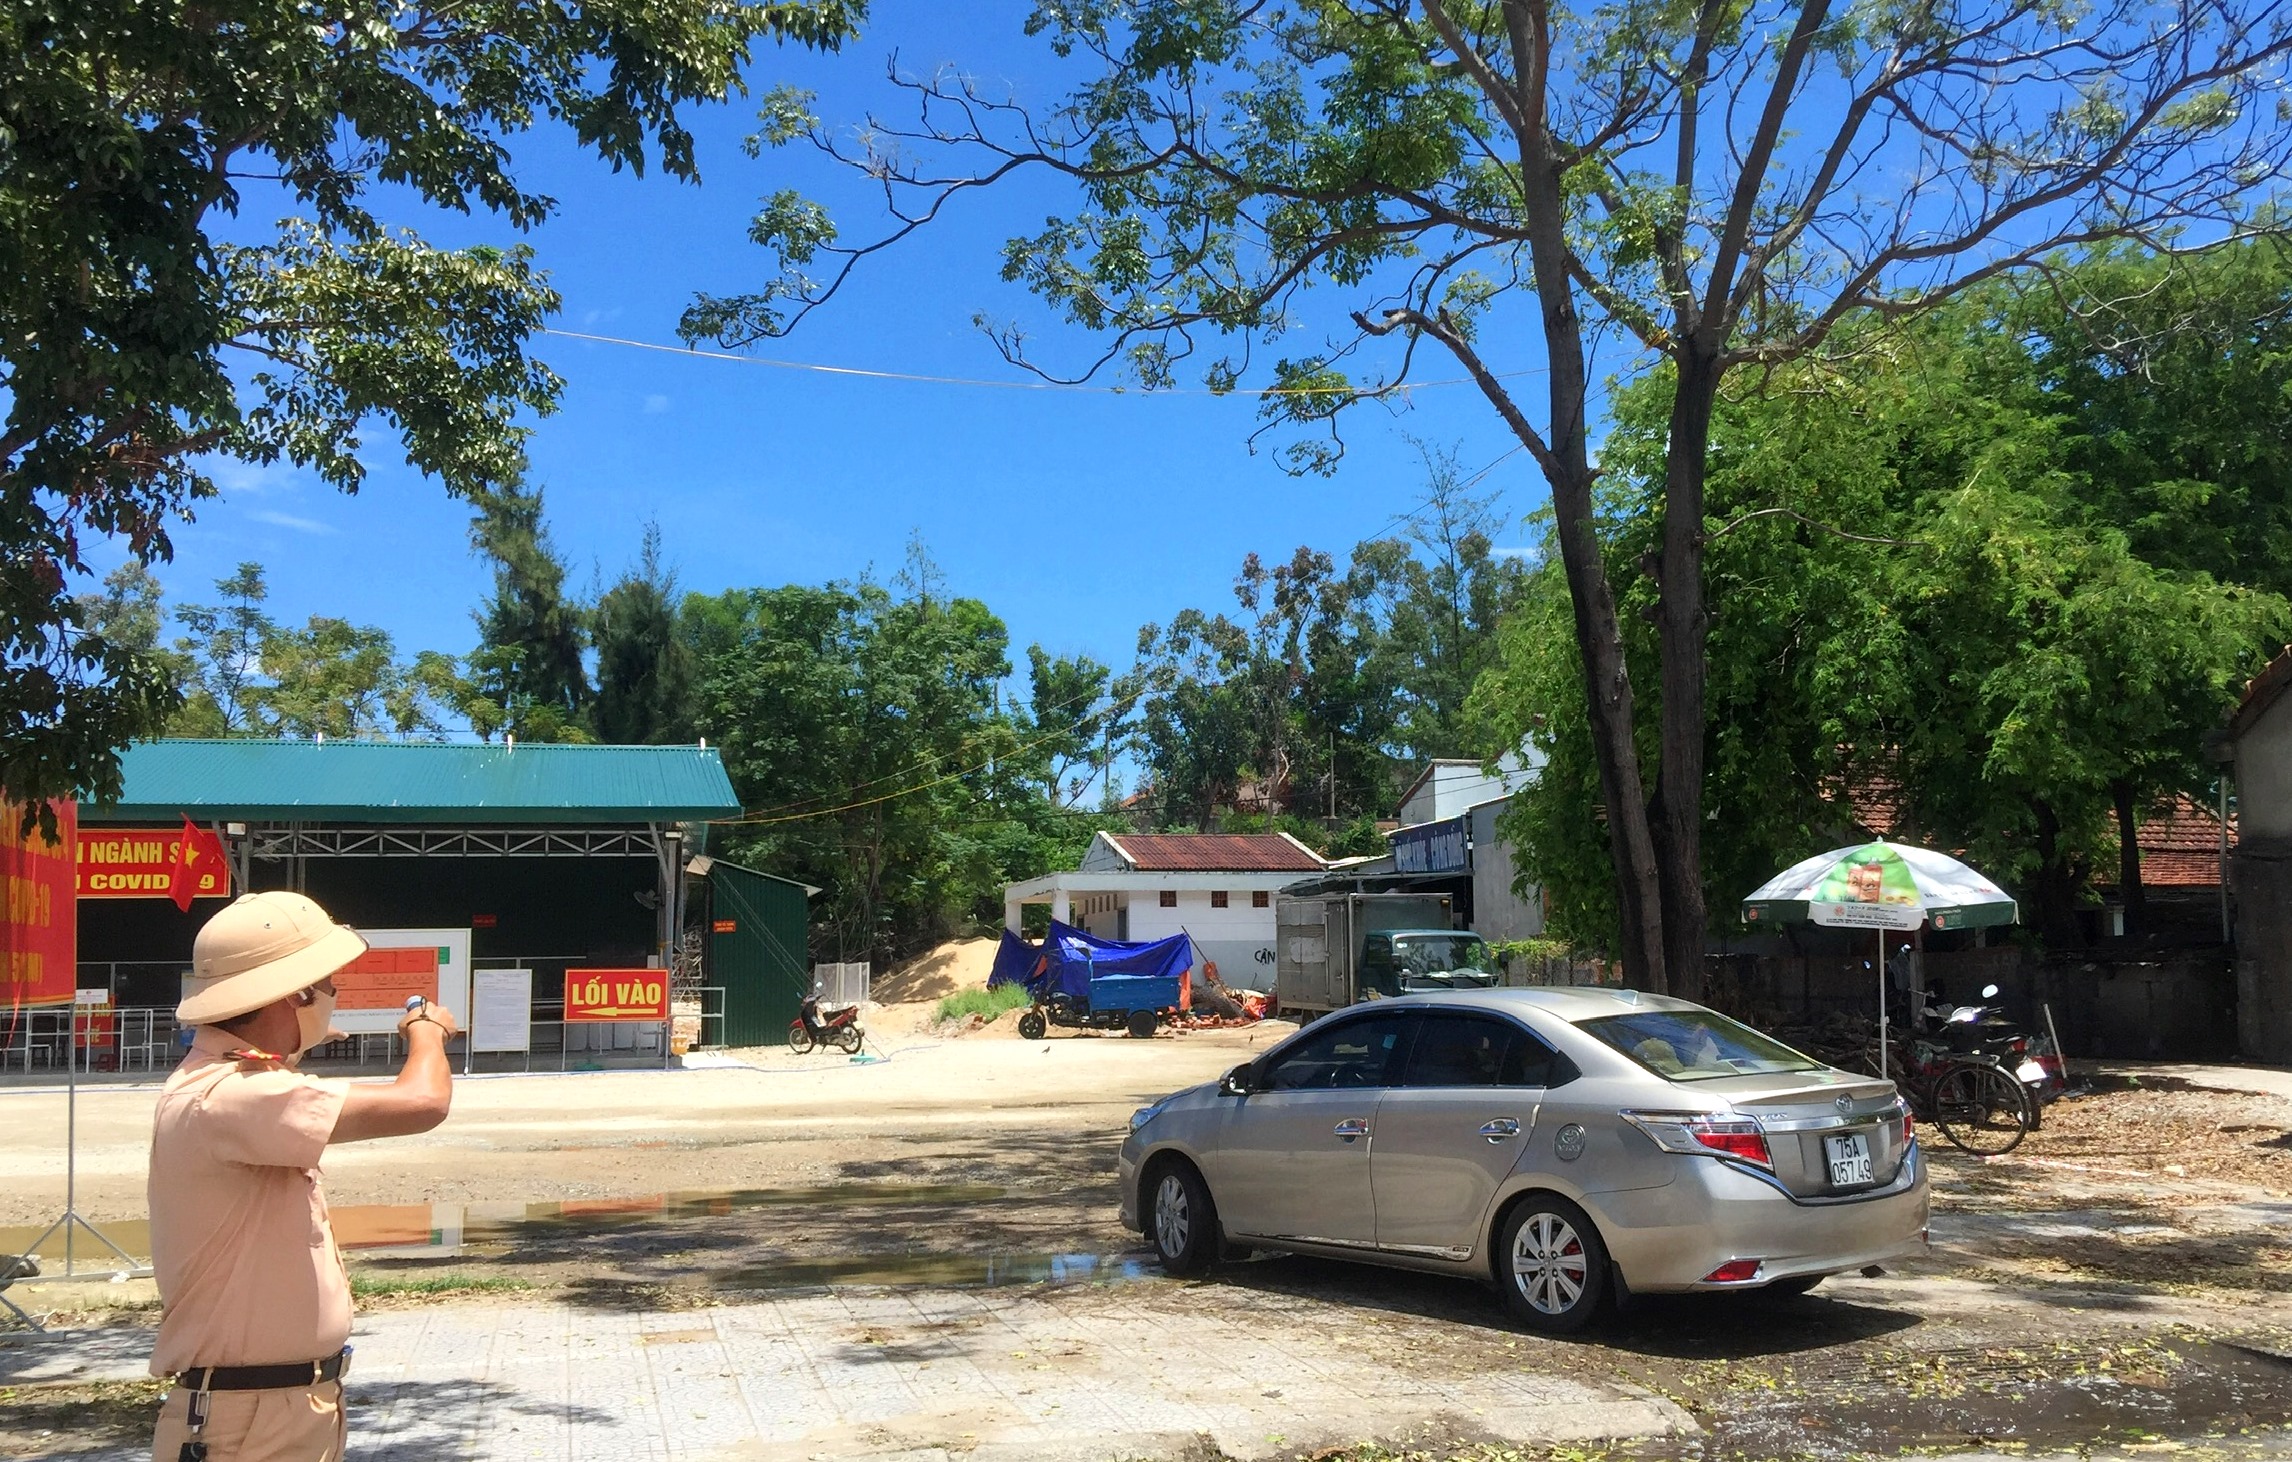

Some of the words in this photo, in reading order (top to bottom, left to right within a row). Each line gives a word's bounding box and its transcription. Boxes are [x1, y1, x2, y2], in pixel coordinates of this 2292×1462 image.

[90, 837, 162, 863] NGÀNH
[572, 976, 608, 1005] LỐI
[615, 979, 661, 1005] VÀO
[1836, 1137, 1861, 1159] 75A
[1832, 1158, 1872, 1184] 057.49
